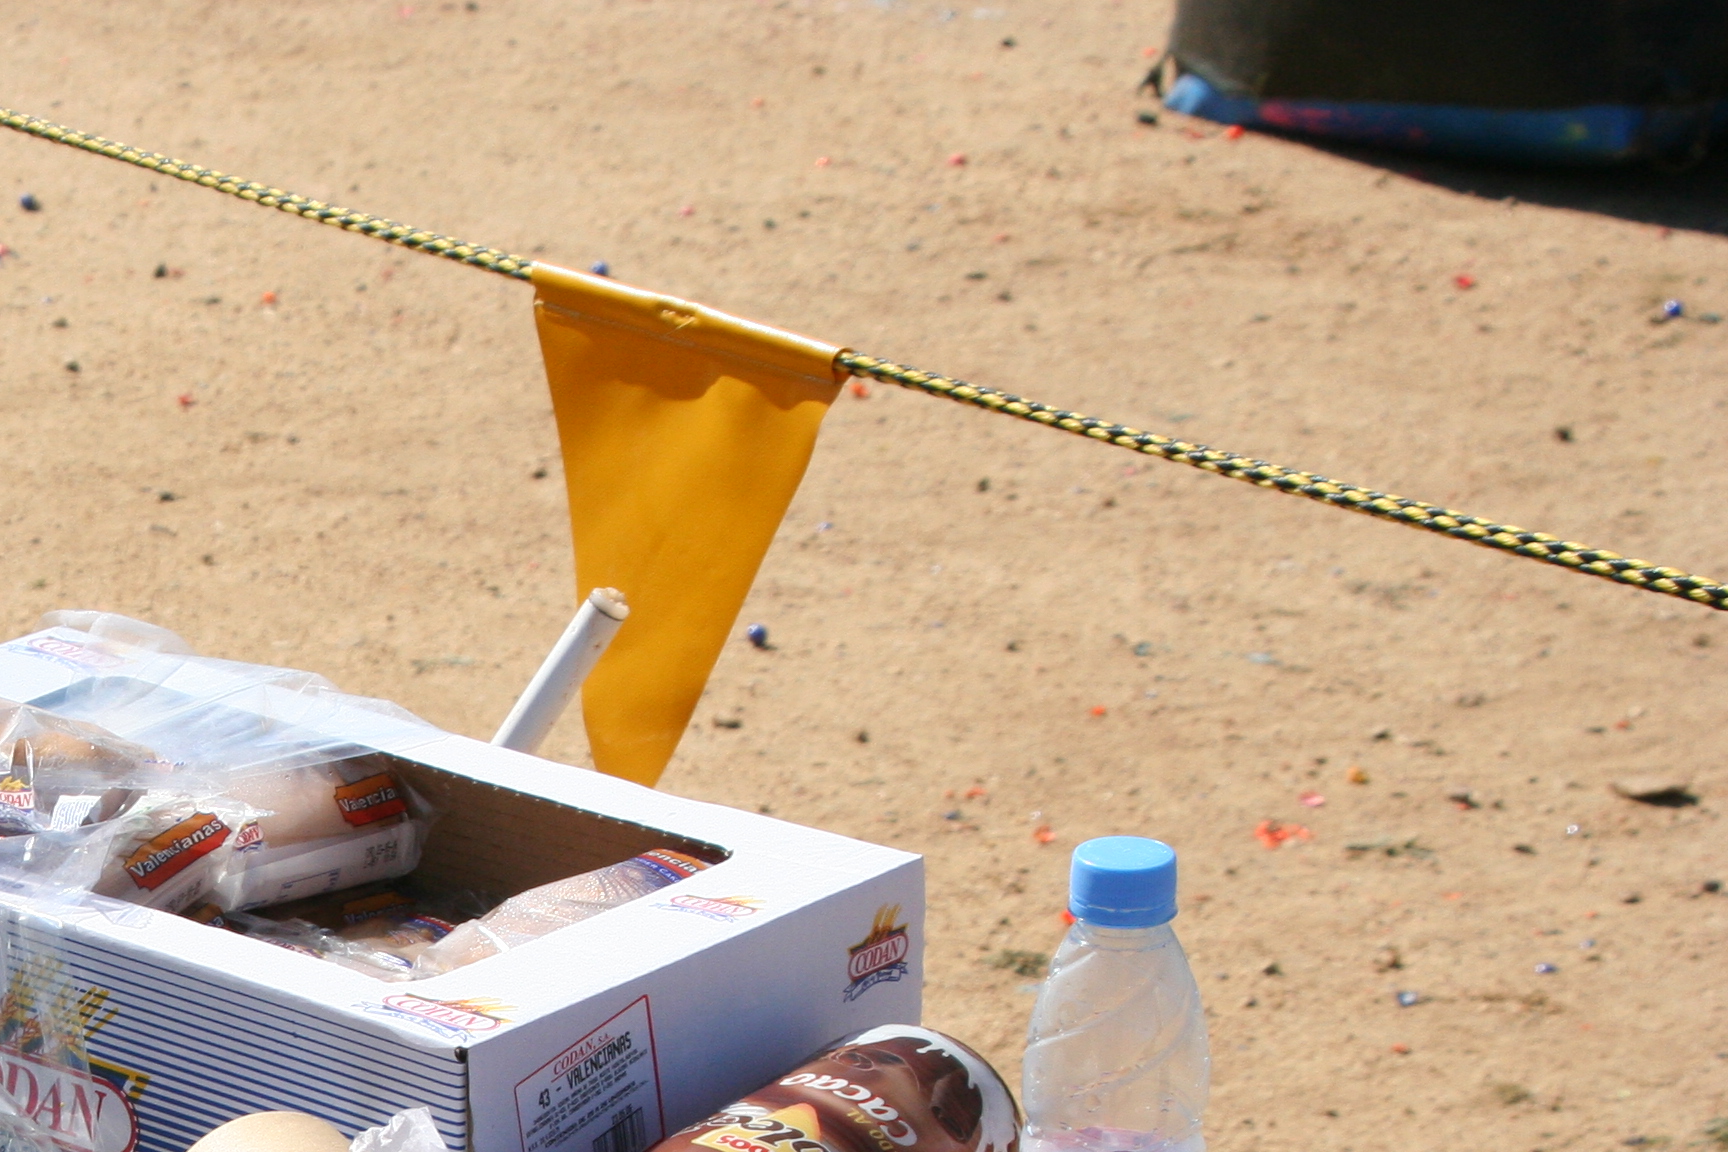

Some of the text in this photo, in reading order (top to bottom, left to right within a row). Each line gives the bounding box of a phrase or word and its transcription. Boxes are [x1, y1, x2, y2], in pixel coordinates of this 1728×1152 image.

[129, 819, 222, 879] Valencianas
[855, 937, 901, 974] CODAN
[397, 999, 486, 1029] CODAN
[538, 1088, 551, 1110] 43
[566, 1031, 632, 1089] VALENCIANAS
[779, 1071, 918, 1148] Cacao
